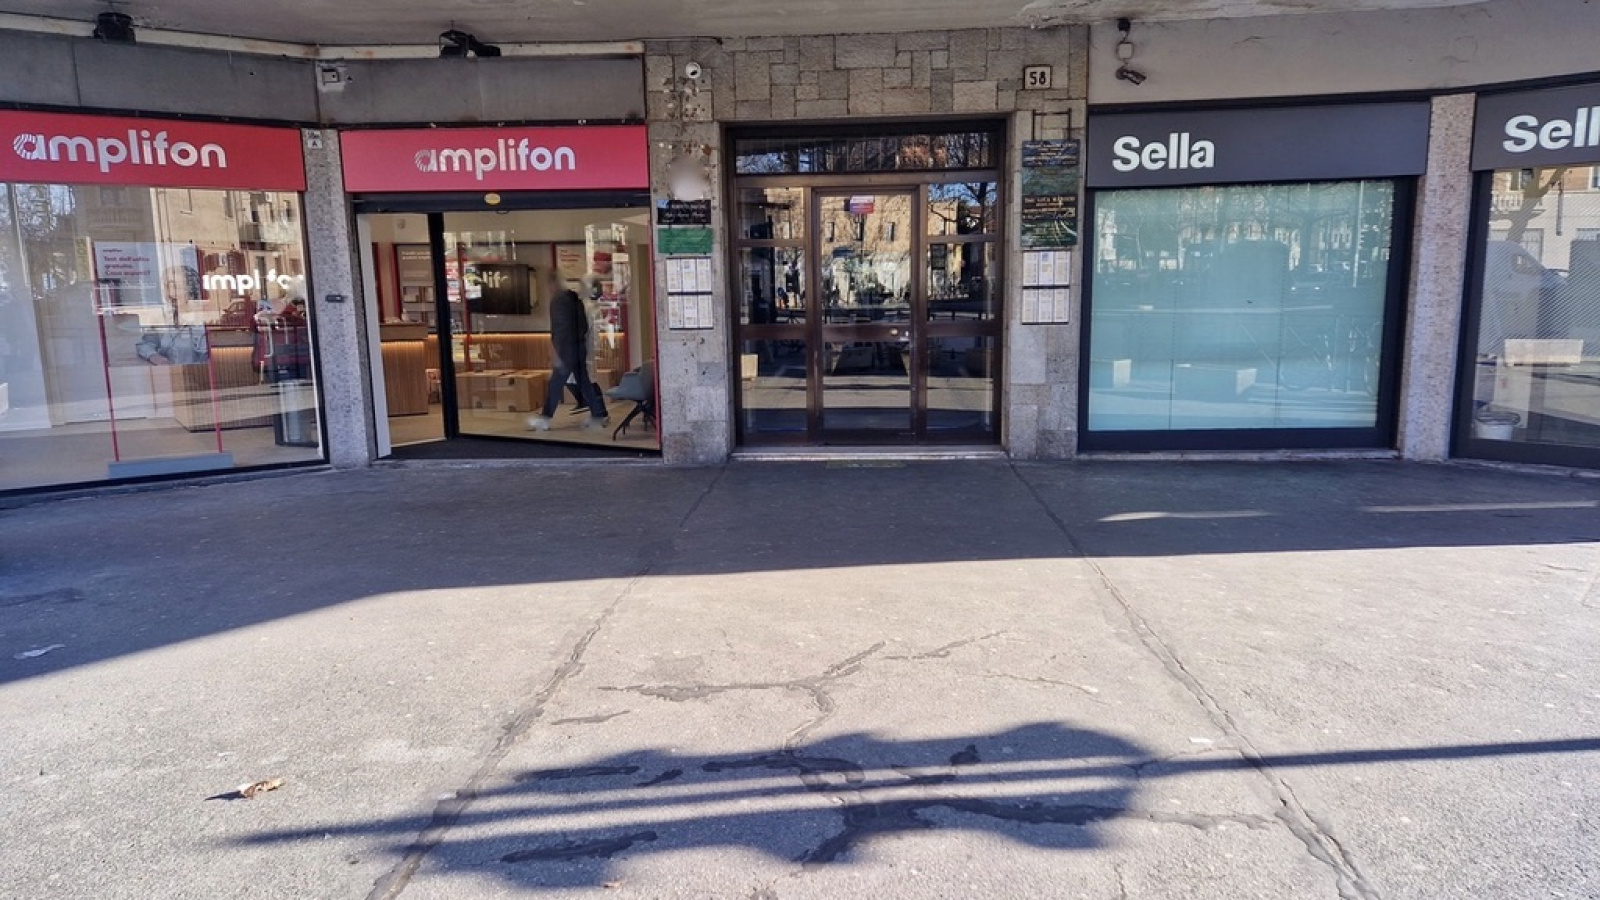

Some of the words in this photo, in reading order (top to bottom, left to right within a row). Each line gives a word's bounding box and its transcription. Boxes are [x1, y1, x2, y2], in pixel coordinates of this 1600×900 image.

[1030, 71, 1046, 85] 58
[13, 129, 227, 172] amplifon
[414, 138, 576, 180] amplifon
[1112, 132, 1215, 172] Sella
